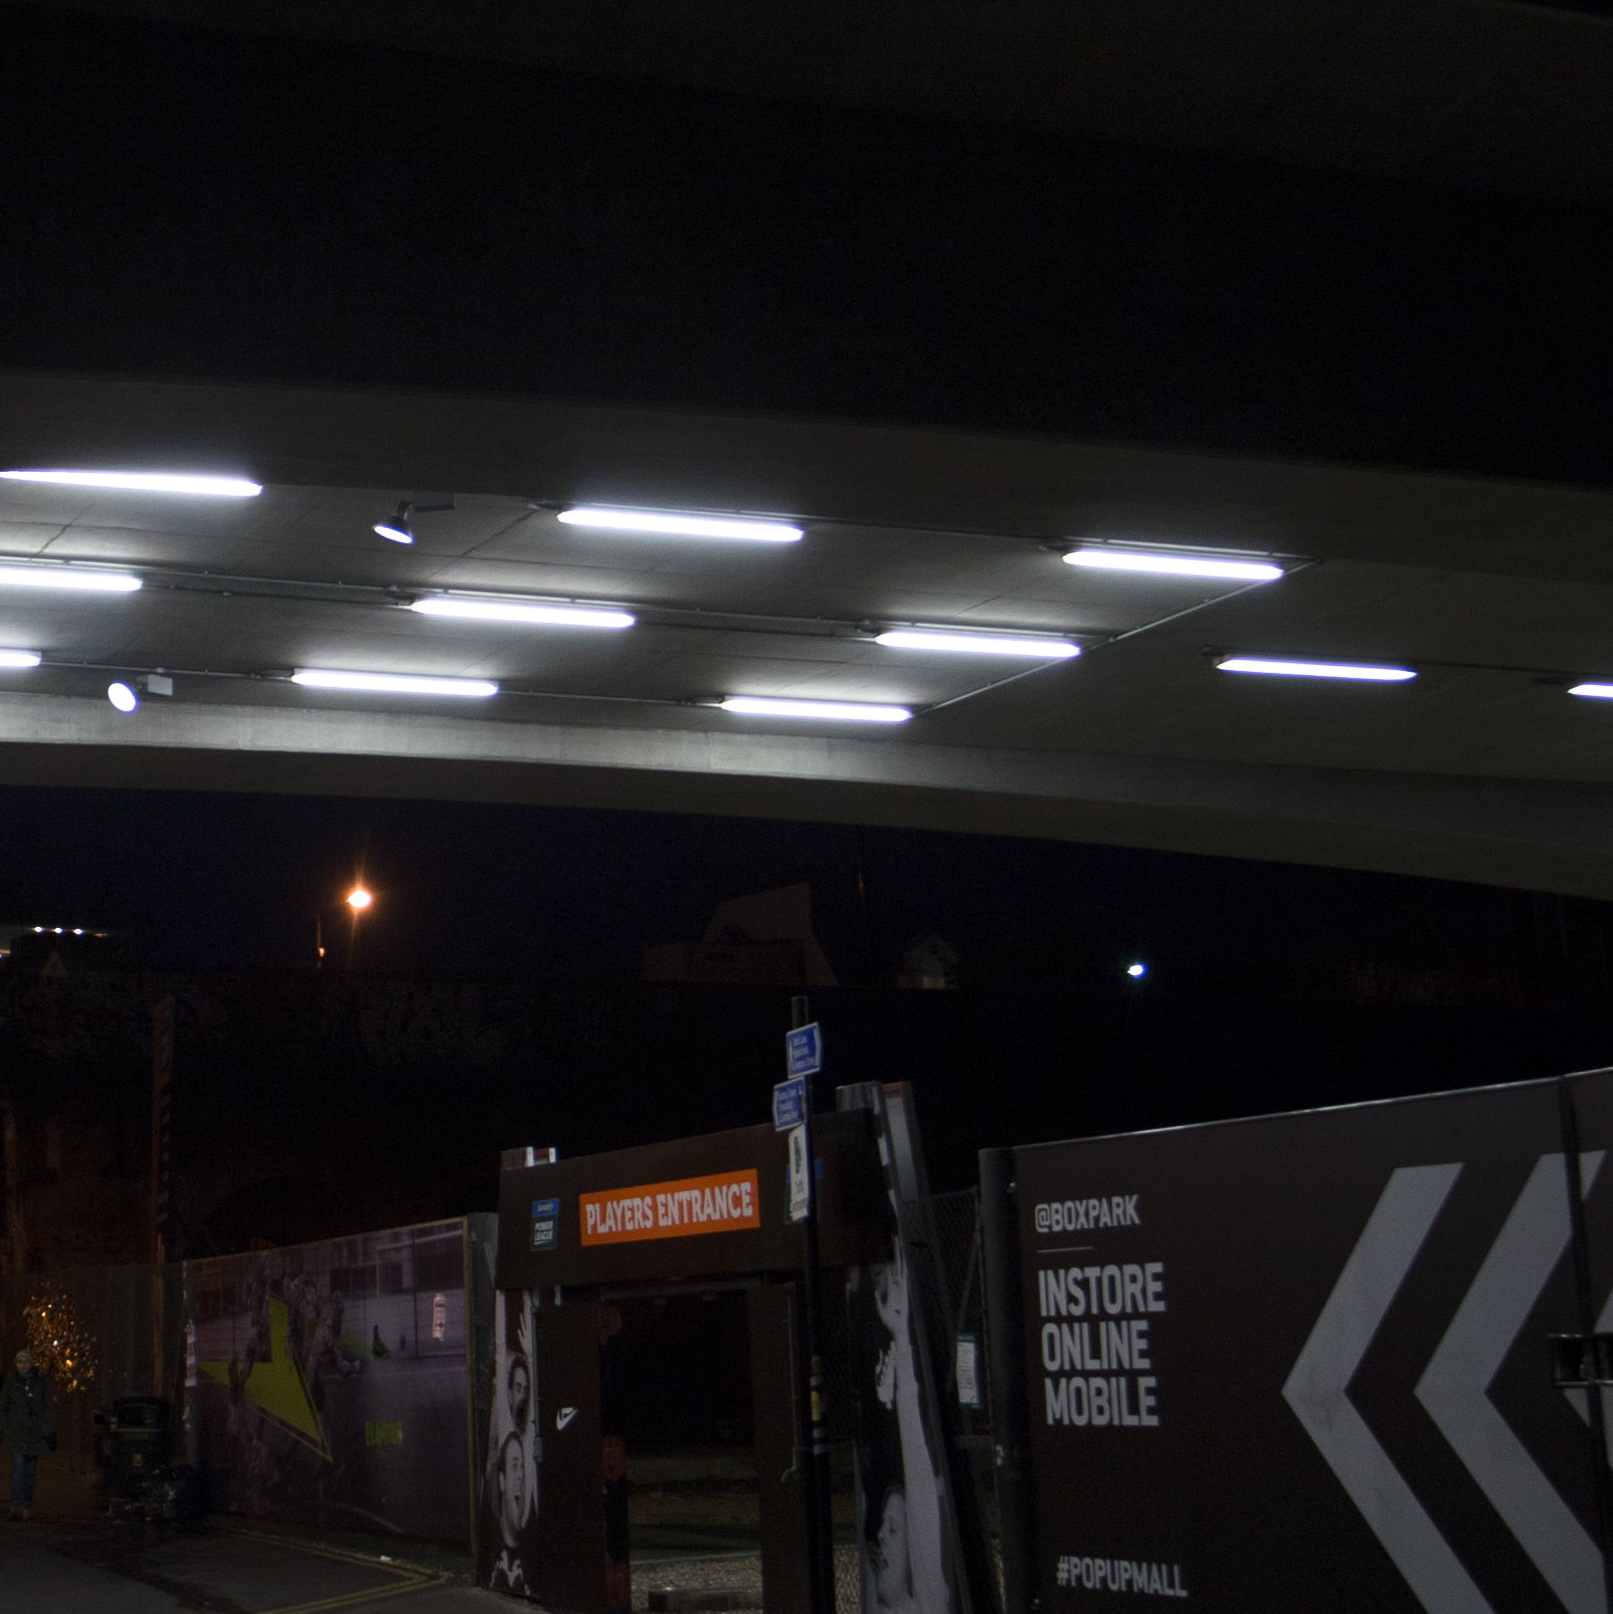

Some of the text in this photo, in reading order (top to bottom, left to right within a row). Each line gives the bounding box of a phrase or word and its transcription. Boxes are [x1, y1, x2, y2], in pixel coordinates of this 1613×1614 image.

[585, 1182, 753, 1235] PLAYERS ENTRANCE
[1035, 1194, 1141, 1234] @BOXPARK
[1038, 1262, 1167, 1317] INSTORE
[1041, 1319, 1152, 1372] ONLINE
[1044, 1376, 1161, 1427] MOBILE
[1056, 1555, 1189, 1598] #POPUPMALL
